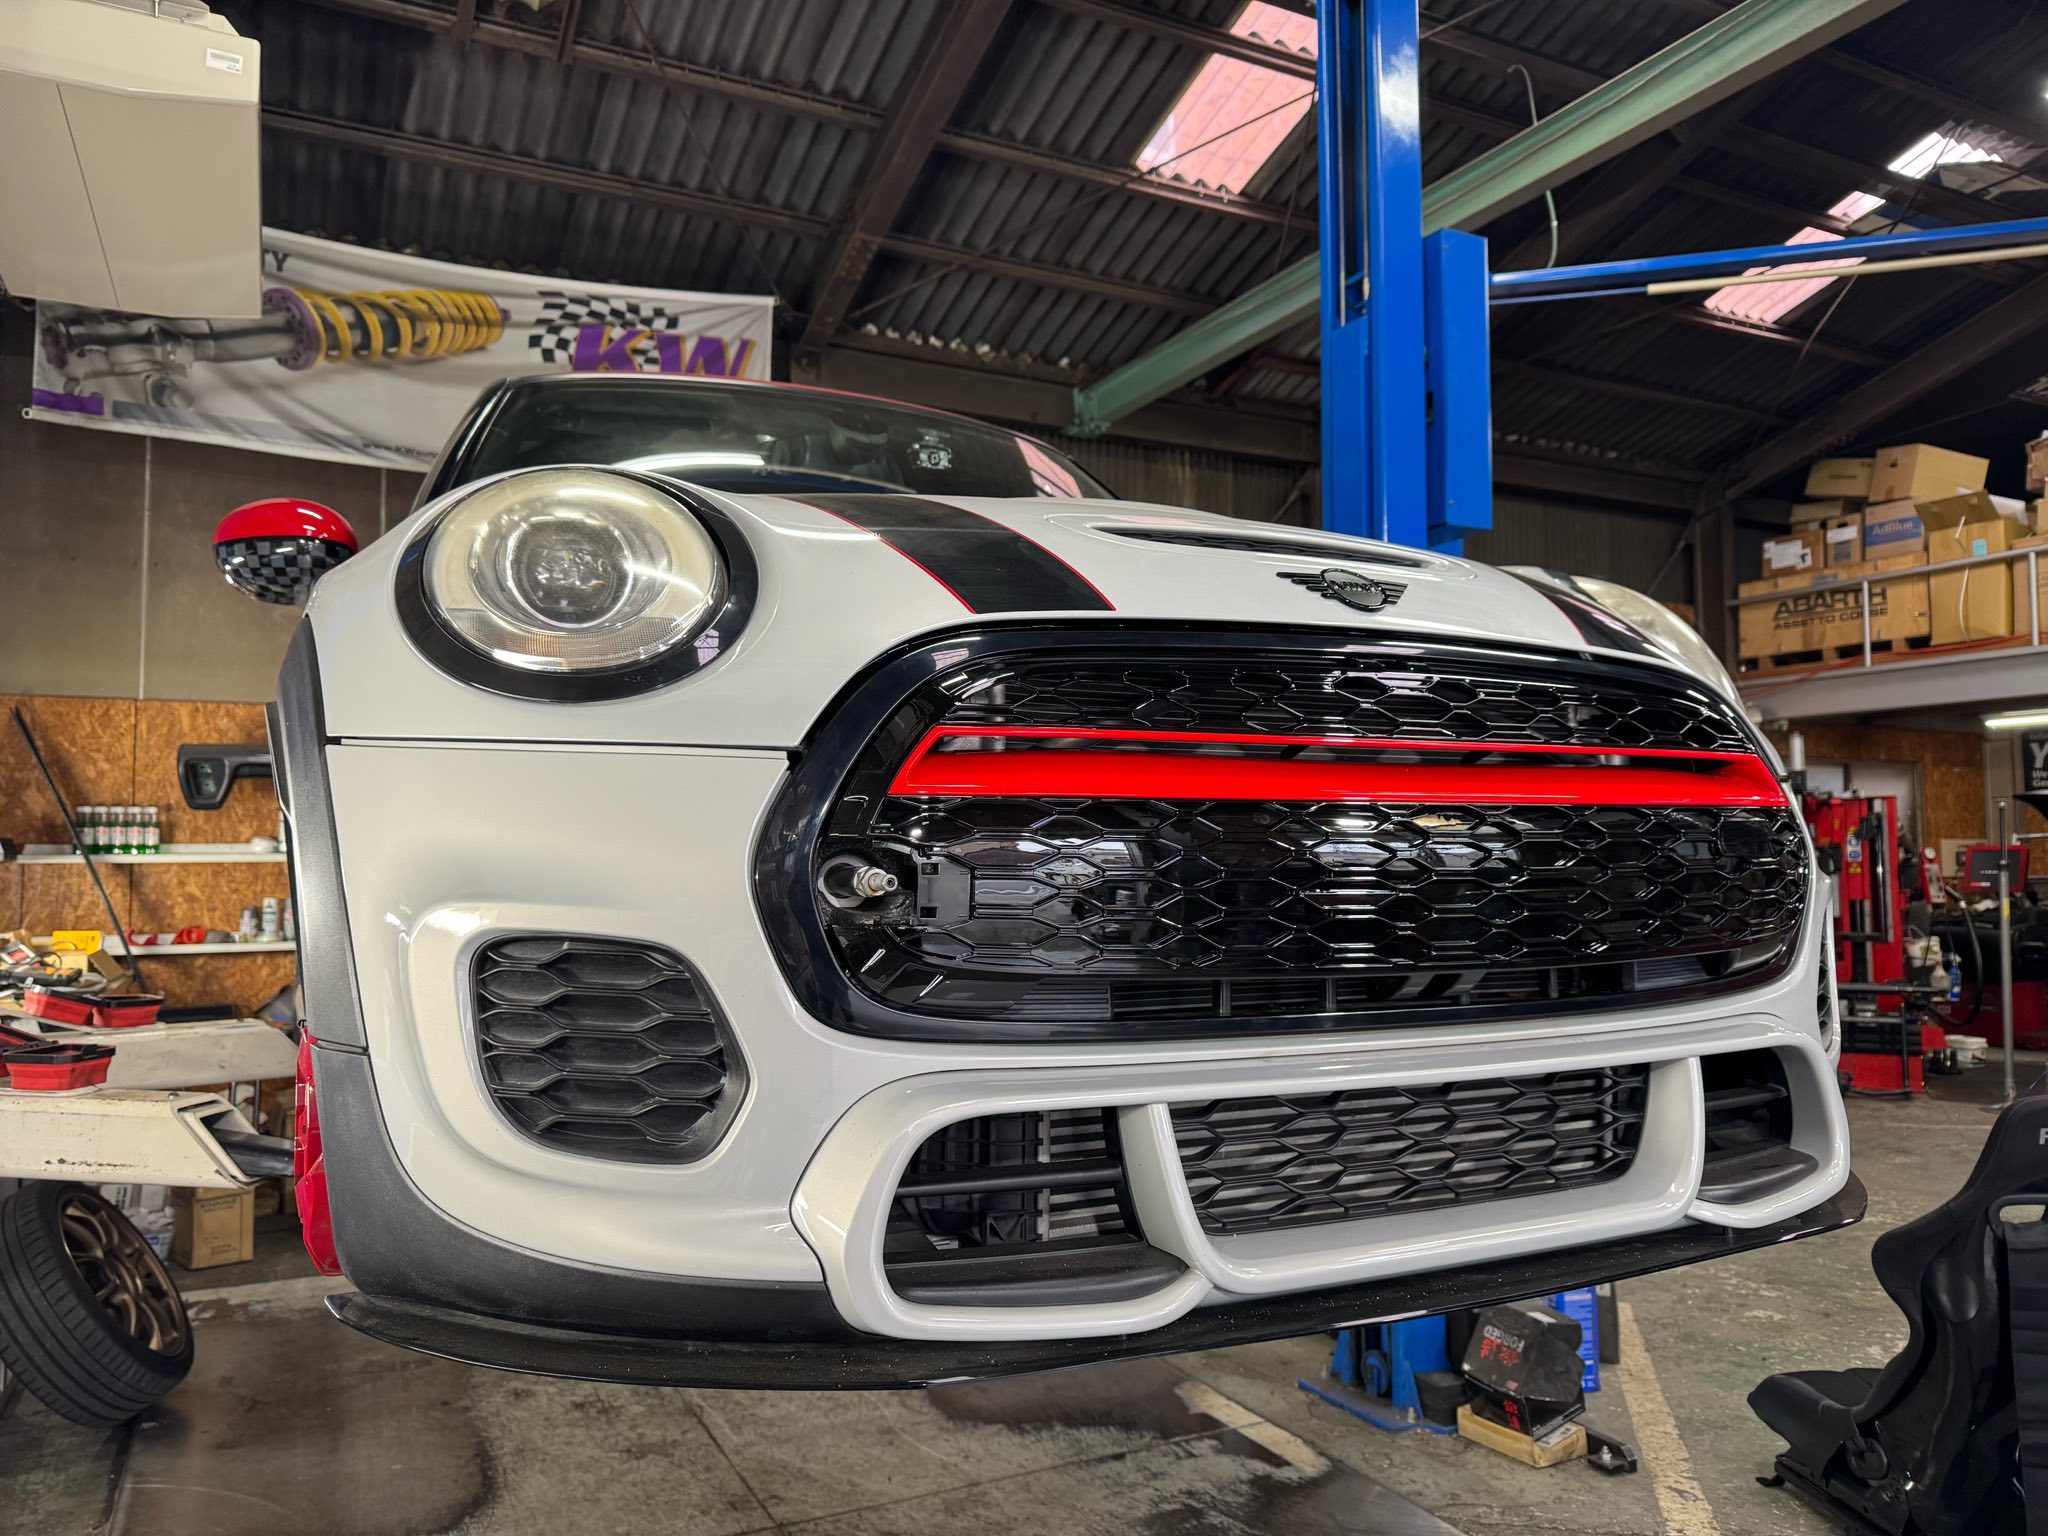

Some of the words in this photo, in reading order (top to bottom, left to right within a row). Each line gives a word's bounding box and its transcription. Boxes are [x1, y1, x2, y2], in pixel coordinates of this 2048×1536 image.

[573, 323, 756, 377] KW
[1871, 520, 1913, 536] AdBlue
[1773, 586, 1888, 619] ABARTH
[1773, 614, 1836, 631] ASSETTO
[1483, 1324, 1525, 1353] FORGED
